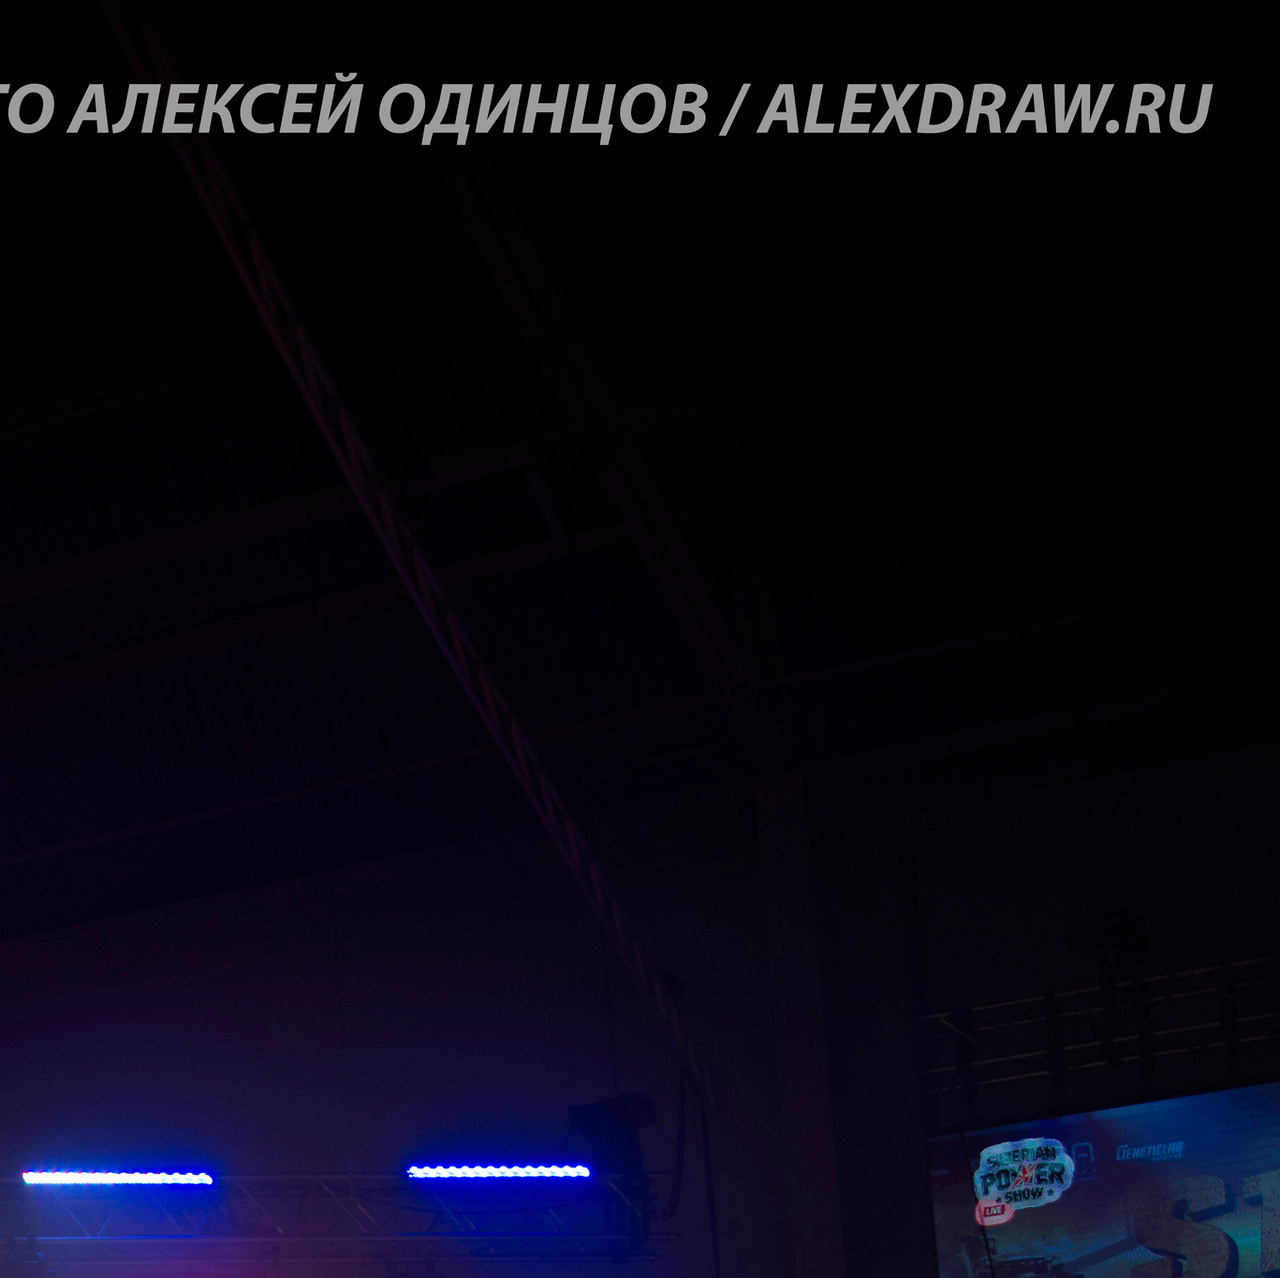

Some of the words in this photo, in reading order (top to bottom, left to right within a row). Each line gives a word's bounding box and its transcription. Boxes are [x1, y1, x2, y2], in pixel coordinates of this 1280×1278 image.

[986, 1145, 1057, 1169] SIBERIAN
[980, 1162, 1066, 1196] POWER
[1005, 1187, 1045, 1204] SHOW
[984, 1205, 1004, 1217] LIVE
